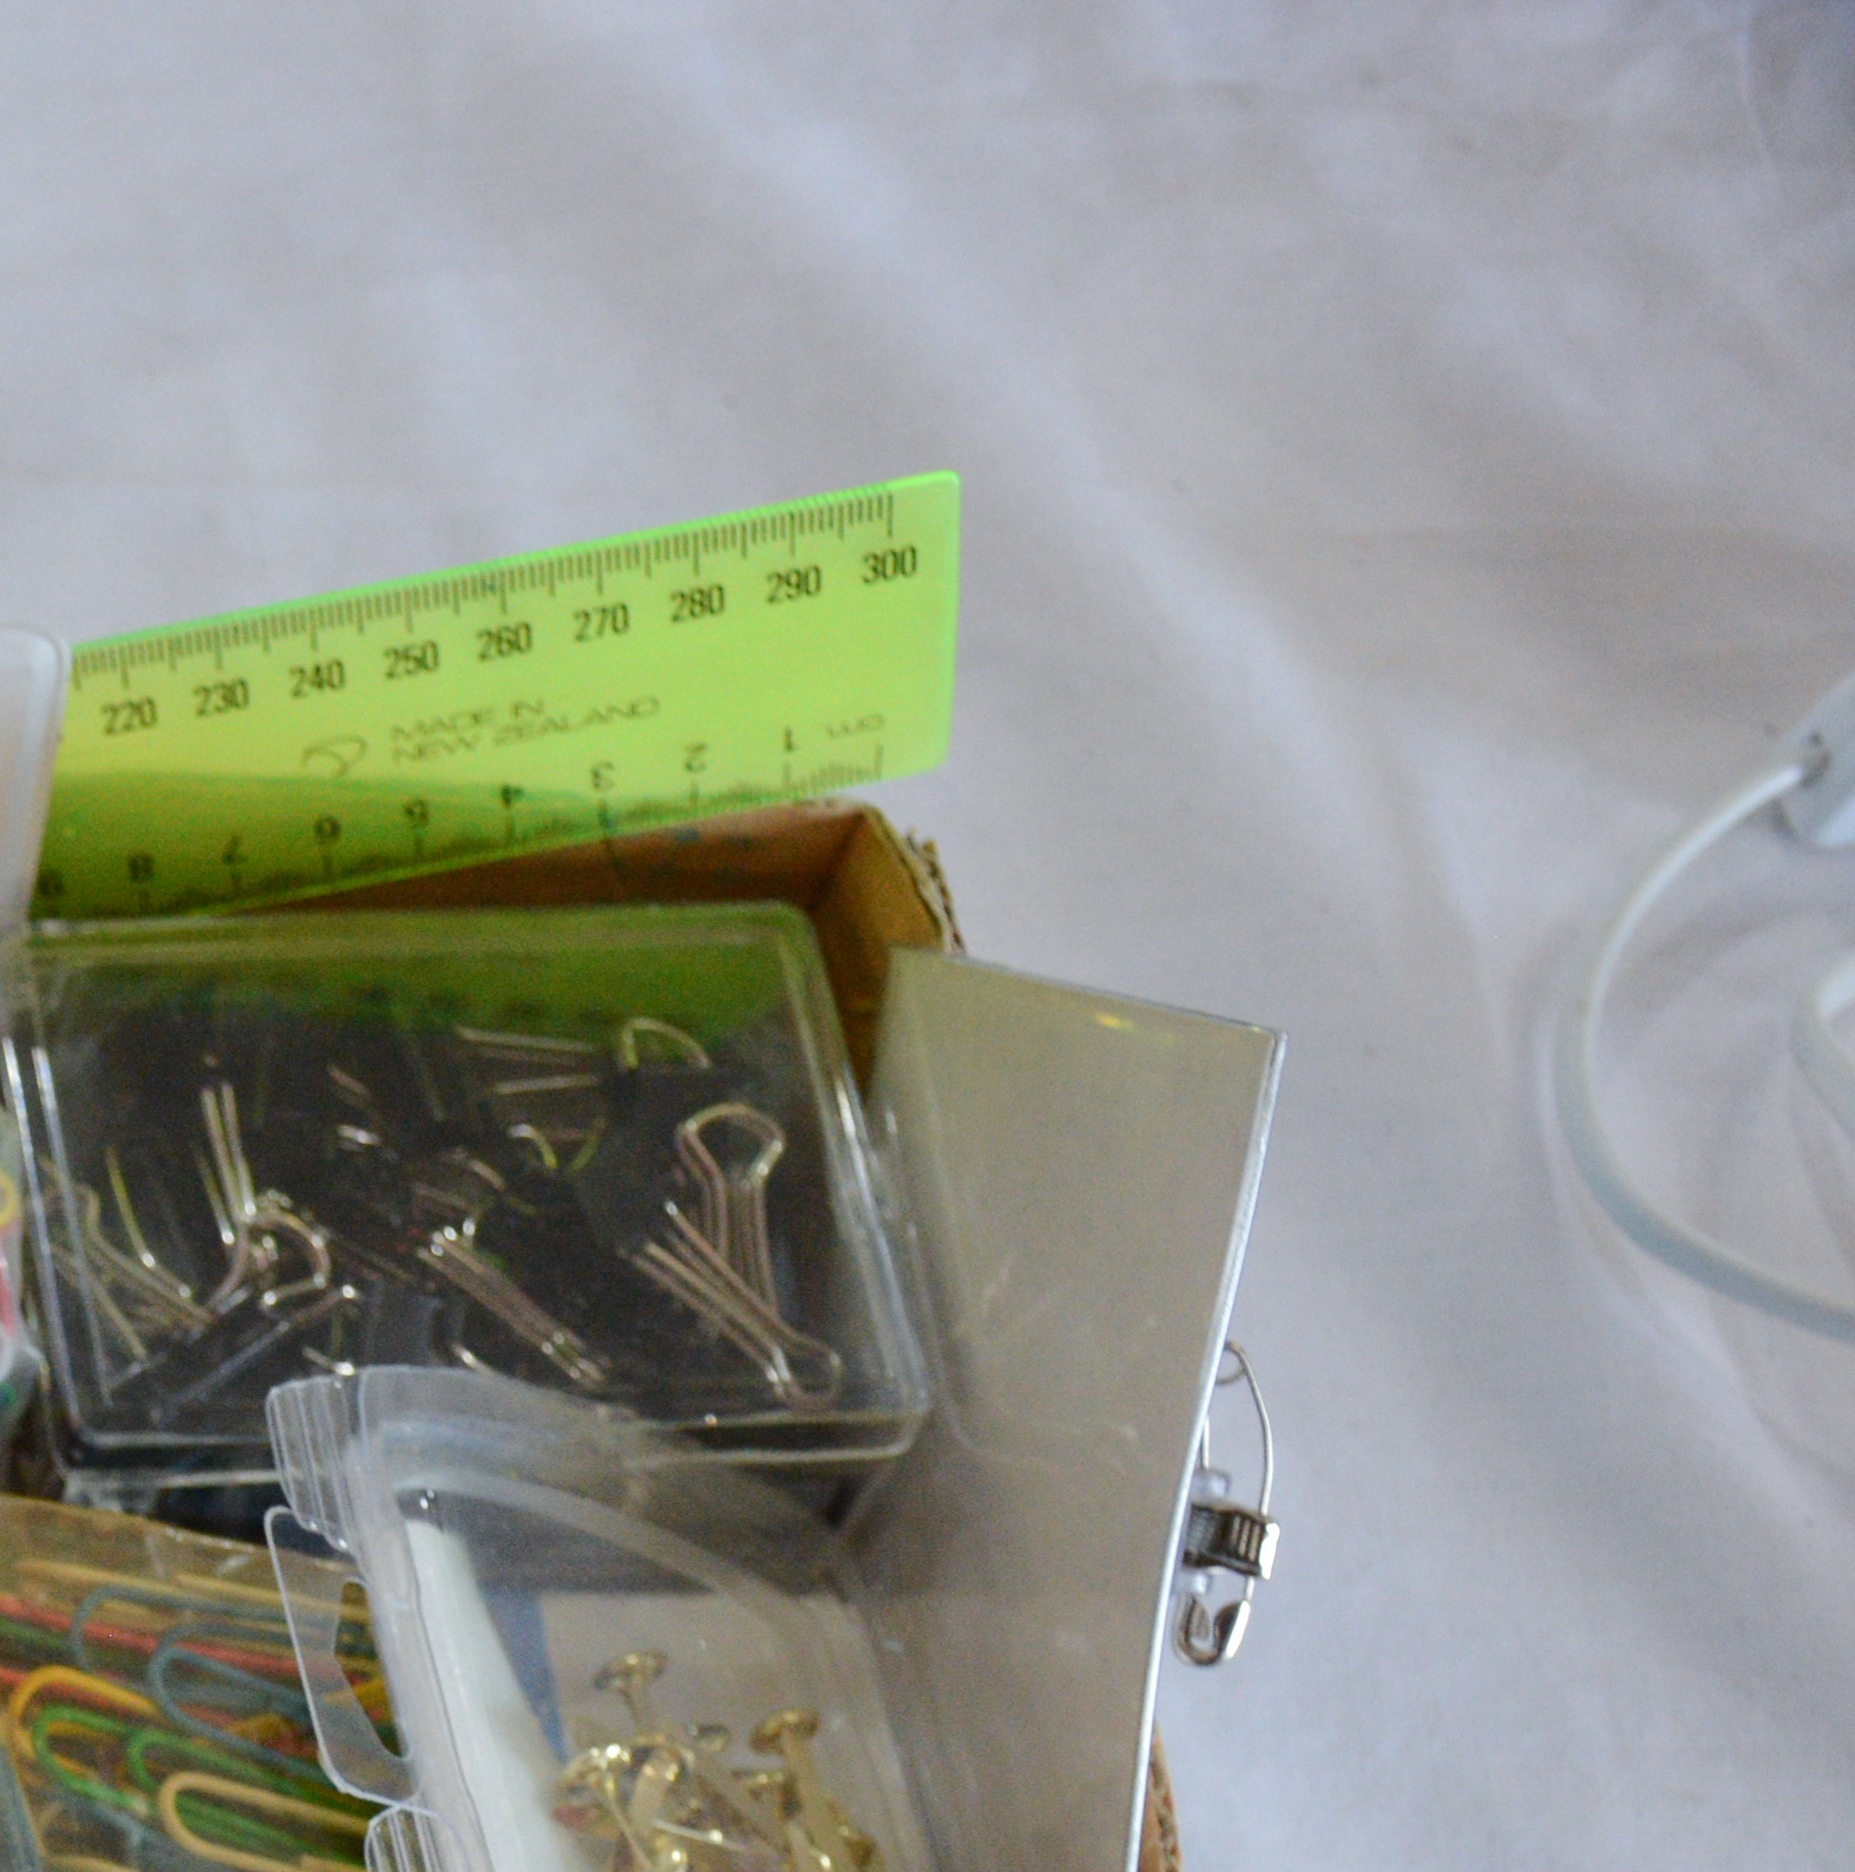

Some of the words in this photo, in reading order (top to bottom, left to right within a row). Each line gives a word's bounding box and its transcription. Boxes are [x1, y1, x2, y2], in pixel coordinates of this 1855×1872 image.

[102, 697, 158, 735] 220
[194, 678, 250, 717] 230
[289, 658, 346, 698] 240
[383, 639, 440, 680] 250
[476, 621, 533, 662] 260
[573, 602, 630, 642] 270
[669, 583, 726, 623] 280
[766, 564, 823, 604] 290
[861, 545, 918, 585] 300
